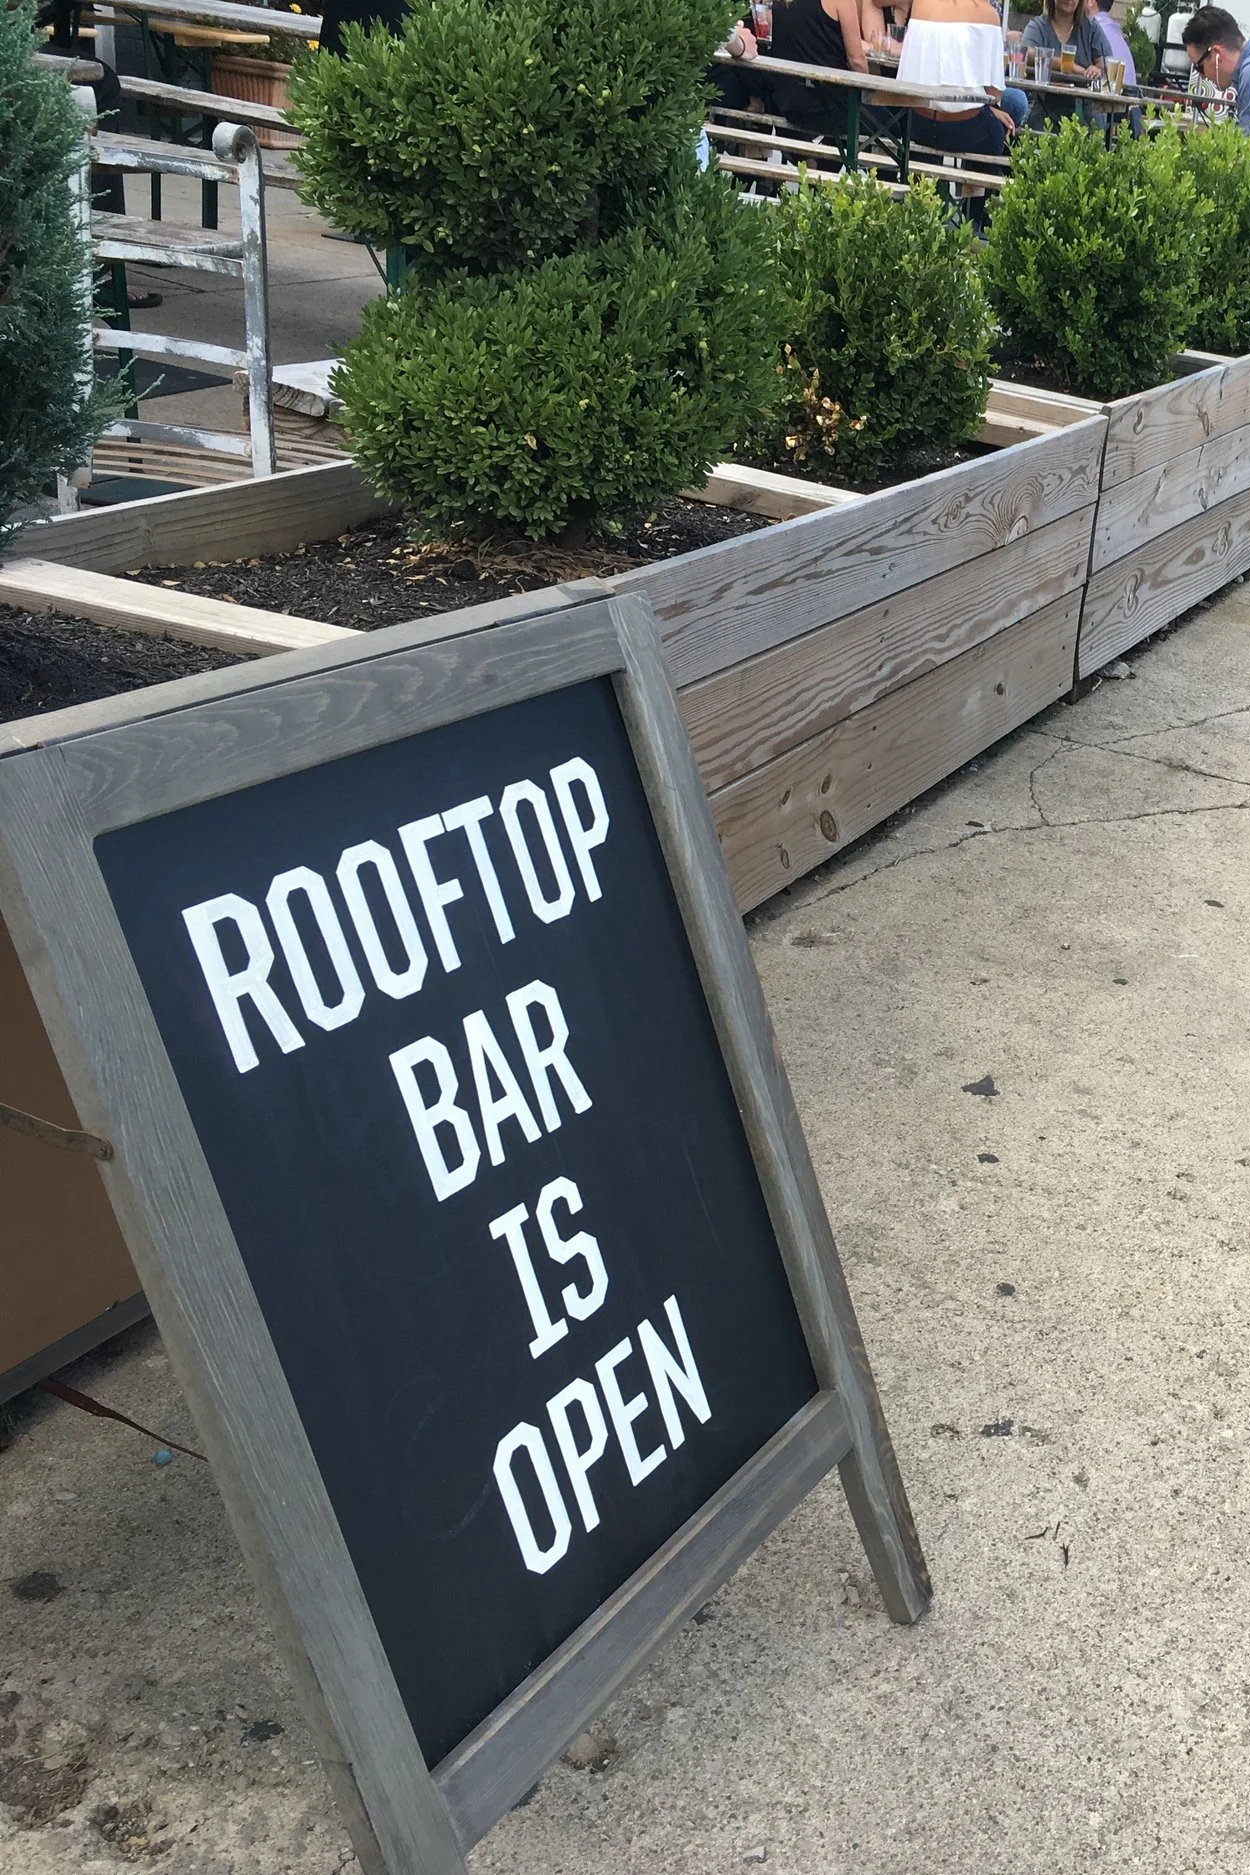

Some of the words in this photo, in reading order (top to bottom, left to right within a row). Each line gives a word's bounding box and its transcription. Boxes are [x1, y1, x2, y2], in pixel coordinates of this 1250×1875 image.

[182, 757, 609, 1073] ROOFTOP
[389, 980, 592, 1201] BAR
[489, 1176, 608, 1359] IS
[493, 1295, 711, 1574] OPEN
